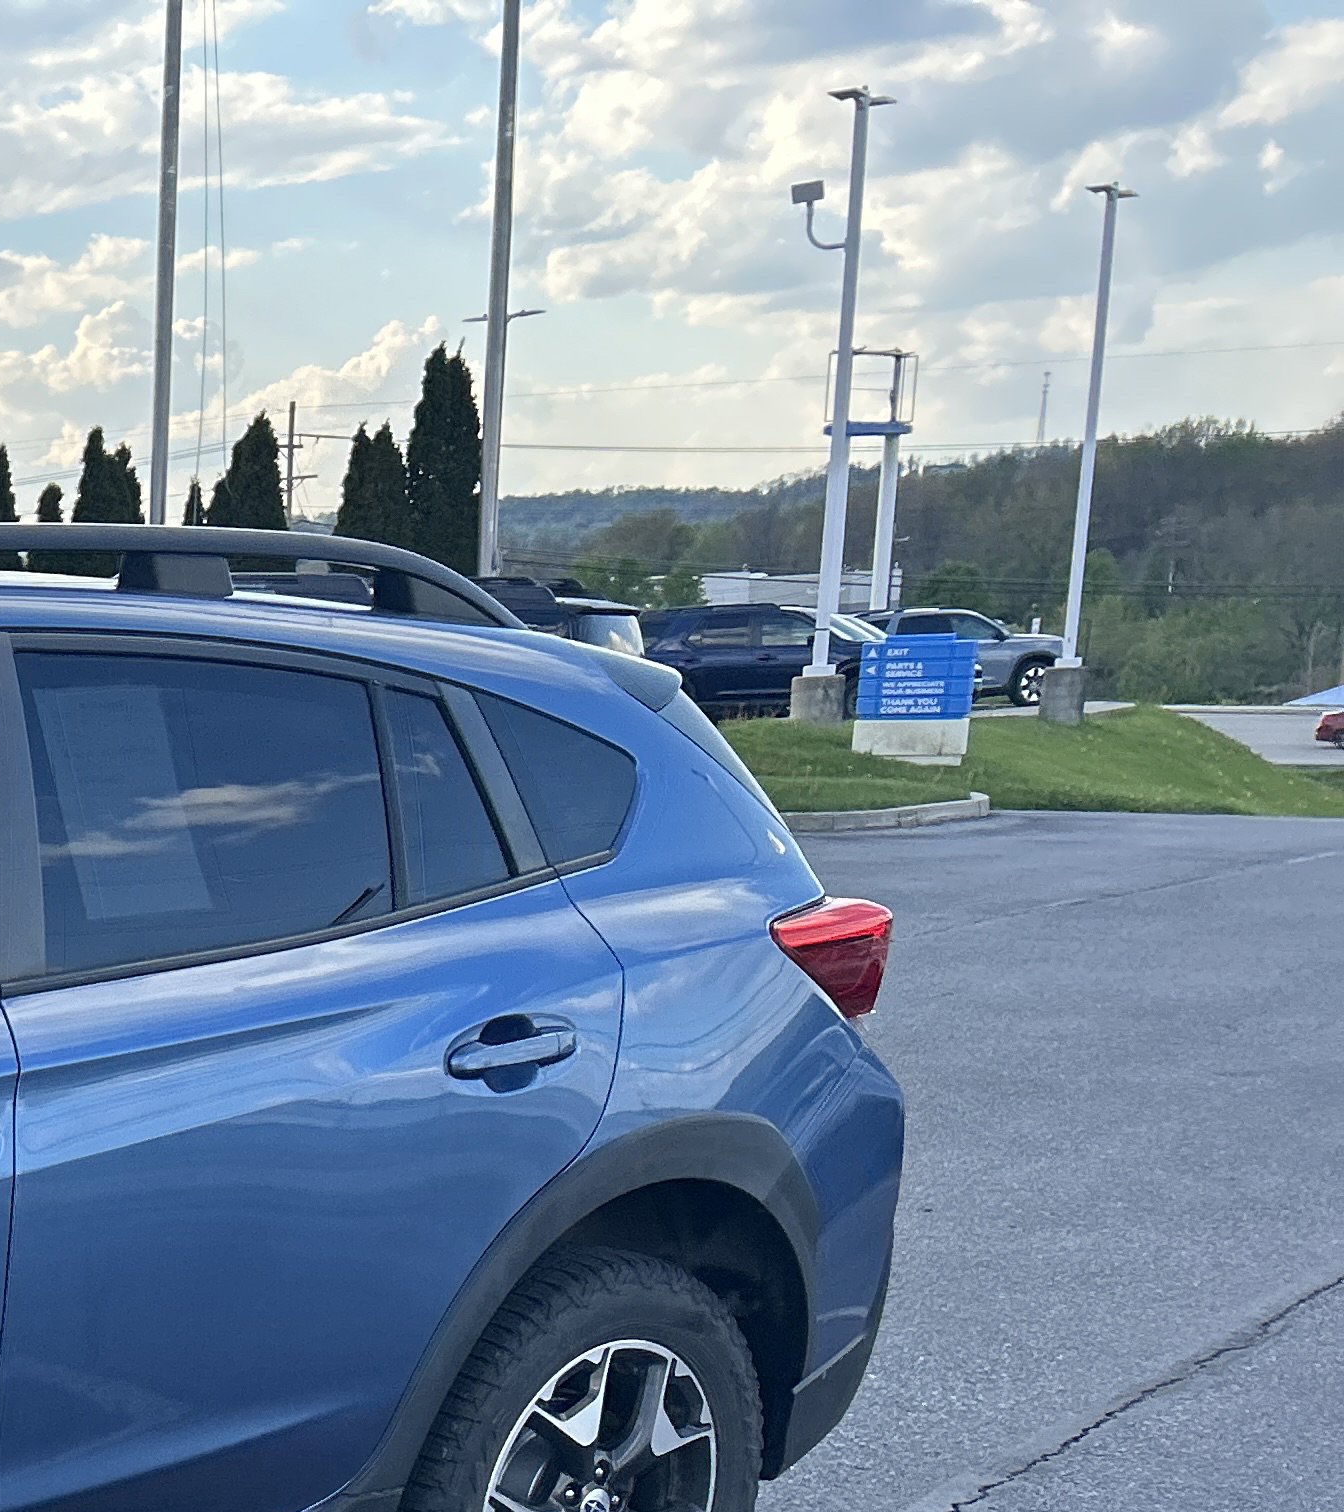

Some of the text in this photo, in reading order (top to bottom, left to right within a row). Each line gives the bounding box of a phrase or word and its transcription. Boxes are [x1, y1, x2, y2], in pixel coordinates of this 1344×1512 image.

[887, 648, 909, 656] EXIT
[917, 698, 938, 706] YOU
[908, 706, 941, 714] AGAIN
